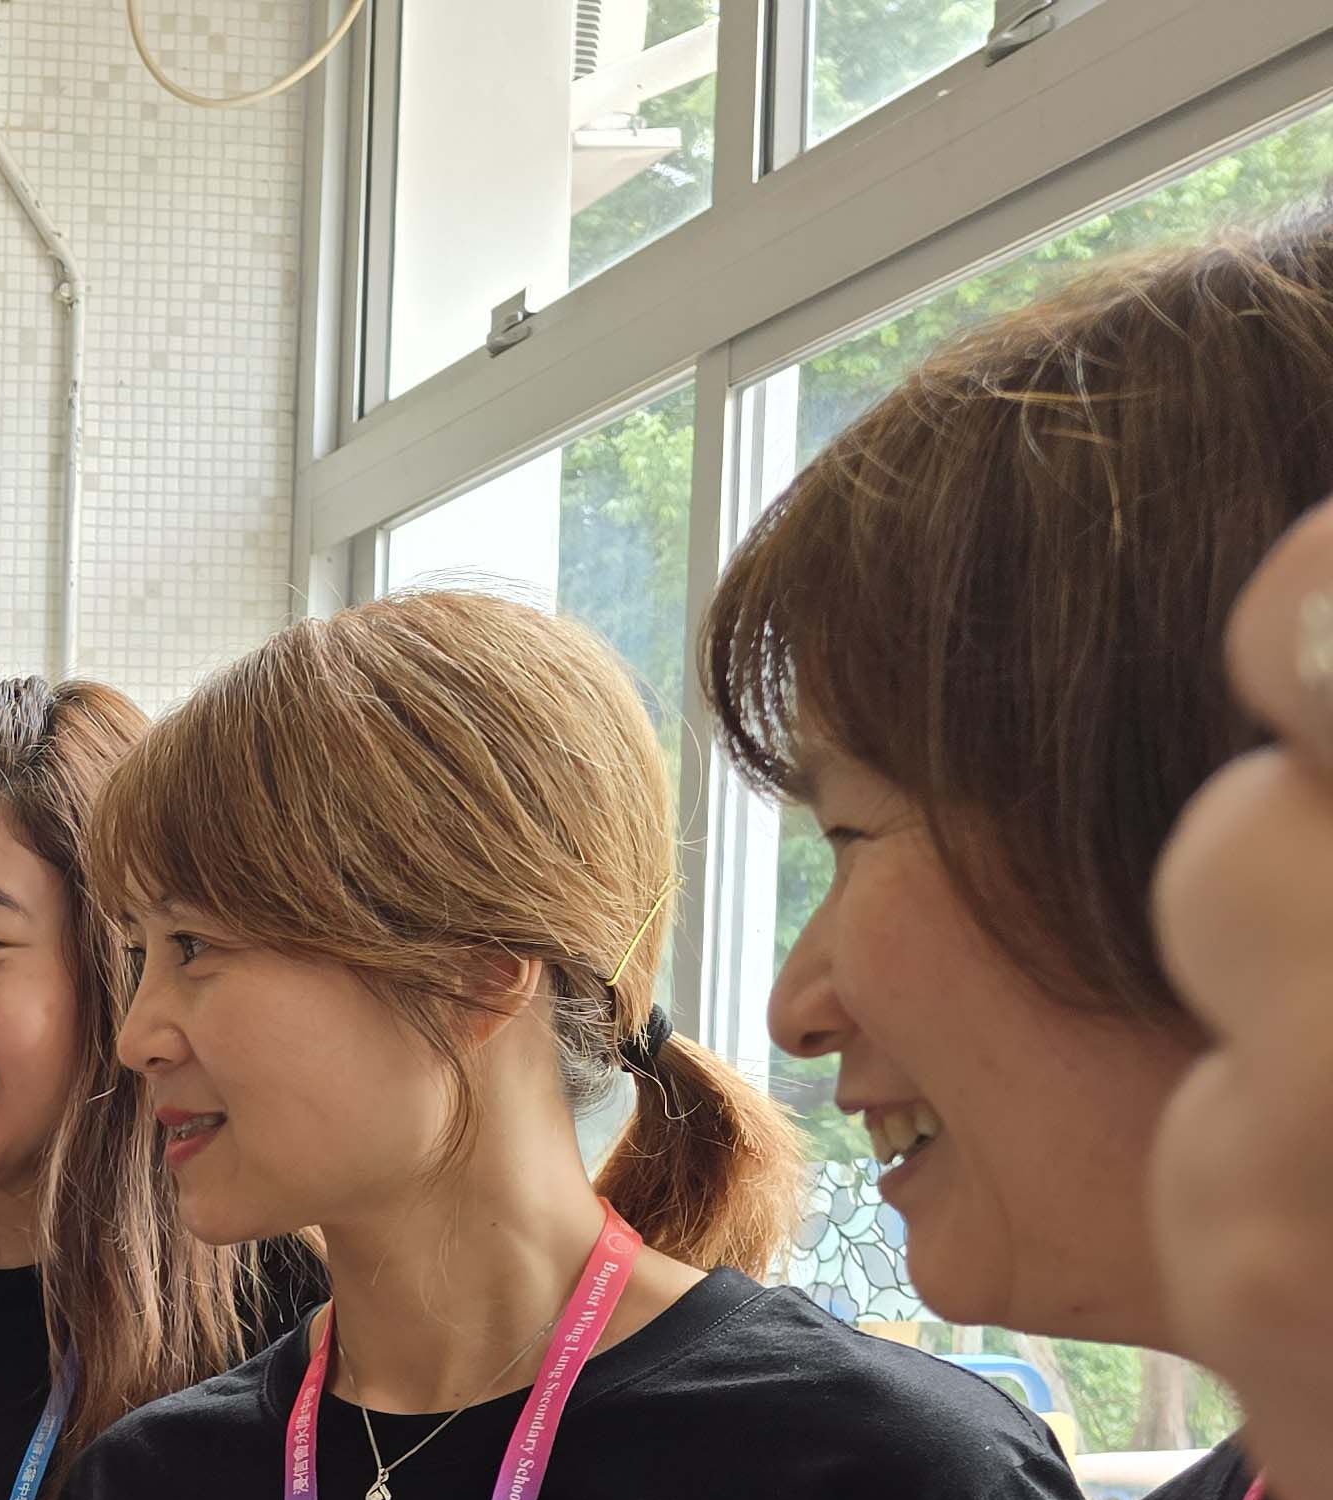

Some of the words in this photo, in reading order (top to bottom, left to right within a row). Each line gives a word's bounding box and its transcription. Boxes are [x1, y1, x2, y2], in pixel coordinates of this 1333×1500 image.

[586, 1261, 619, 1307] Baptist
[564, 1310, 598, 1344] Wing
[548, 1346, 580, 1380] Lung
[520, 1382, 561, 1456] Secondary
